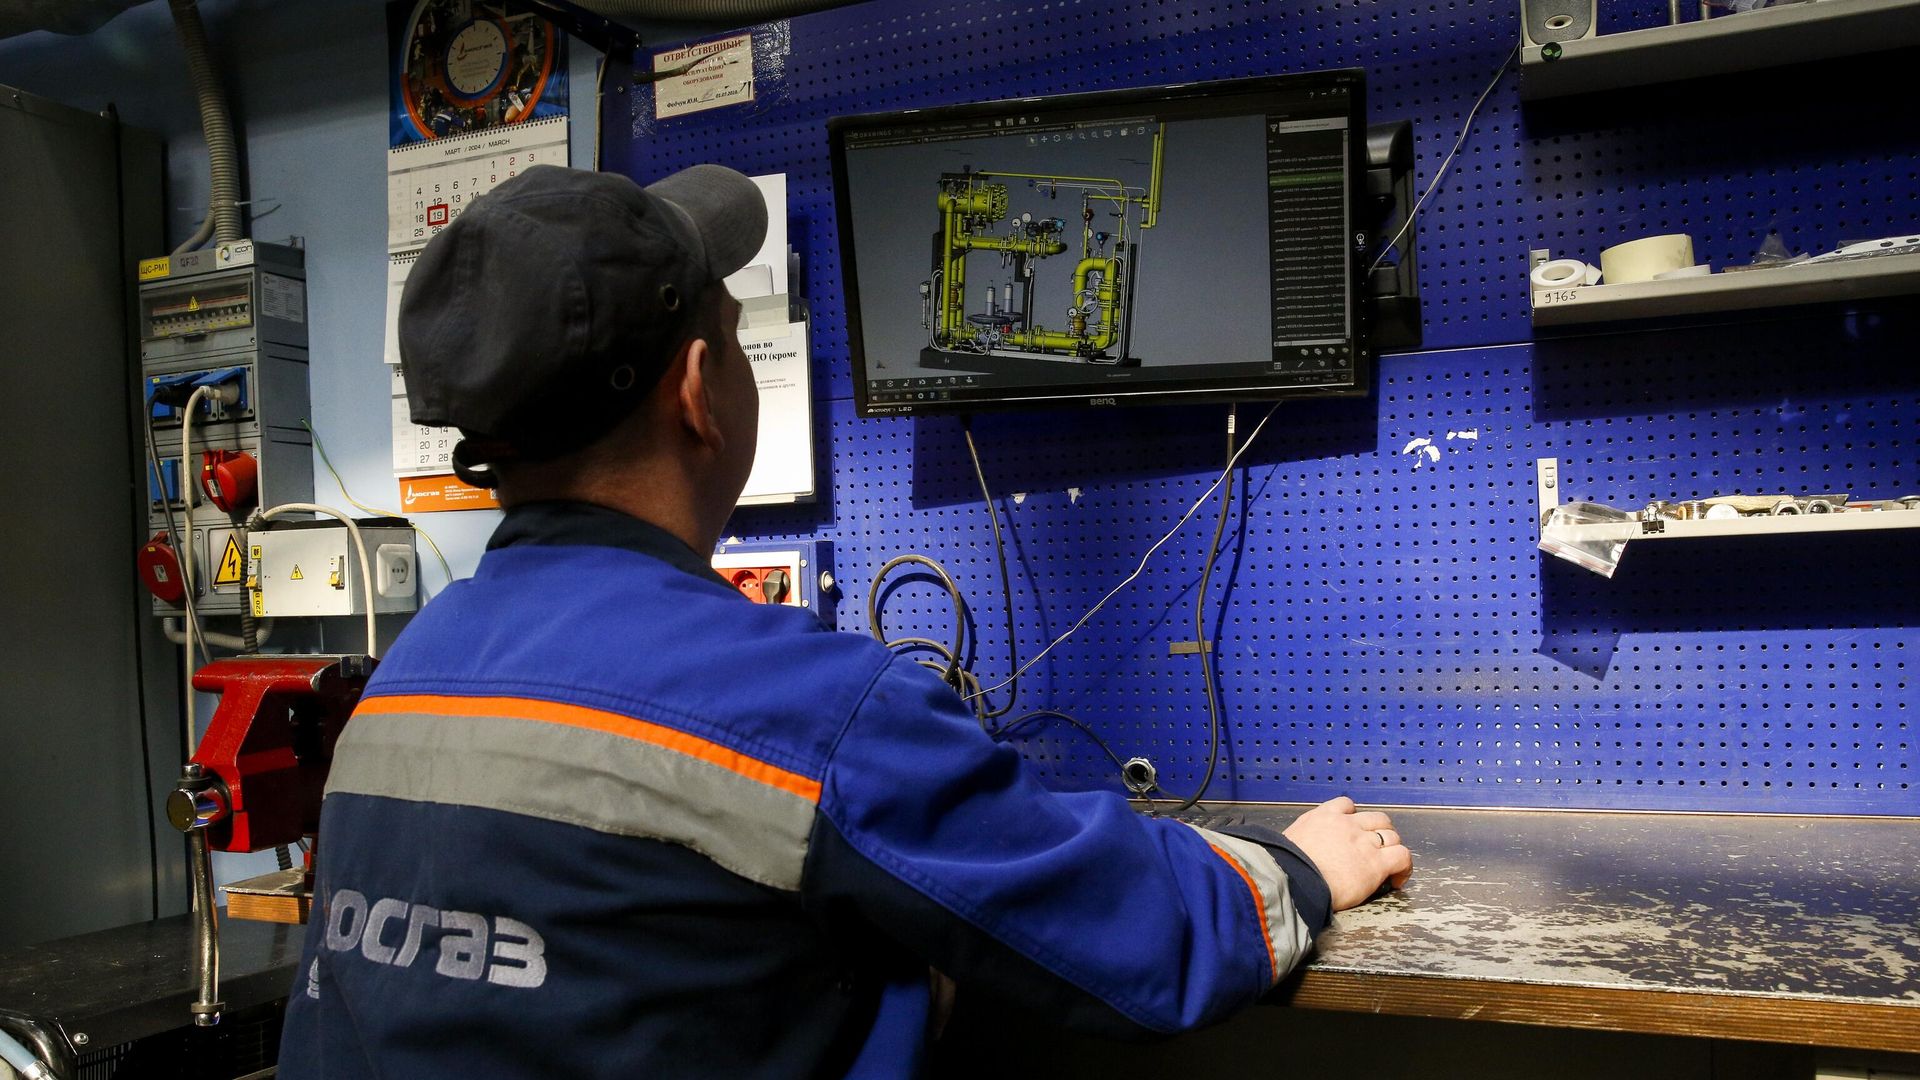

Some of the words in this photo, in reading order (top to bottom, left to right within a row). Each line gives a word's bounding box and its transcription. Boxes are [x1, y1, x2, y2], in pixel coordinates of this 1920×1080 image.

[664, 39, 741, 63] ОТВЕТСТВЕННЫЙ
[445, 148, 461, 156] МАРТ
[489, 139, 511, 148] MARCH
[509, 157, 515, 166] 2
[528, 154, 535, 162] 3
[416, 187, 422, 196] 4
[453, 181, 459, 189] 6
[471, 178, 478, 186] 7
[490, 175, 496, 183] 8
[415, 201, 424, 209] 11
[433, 198, 442, 206] 12
[451, 195, 461, 203] 13
[415, 214, 424, 223] 18
[433, 211, 443, 220] 19
[414, 228, 424, 237] 25
[742, 342, 761, 351] онов
[763, 341, 773, 349] во
[747, 353, 767, 362] ЕНО
[768, 351, 798, 362] (кроме
[1090, 397, 1117, 406] BenQ
[420, 427, 430, 435] 13
[420, 441, 430, 450] 20
[438, 440, 448, 448] 21
[420, 455, 430, 463] 27
[438, 453, 449, 462] 28
[326, 888, 548, 989] осгаз
